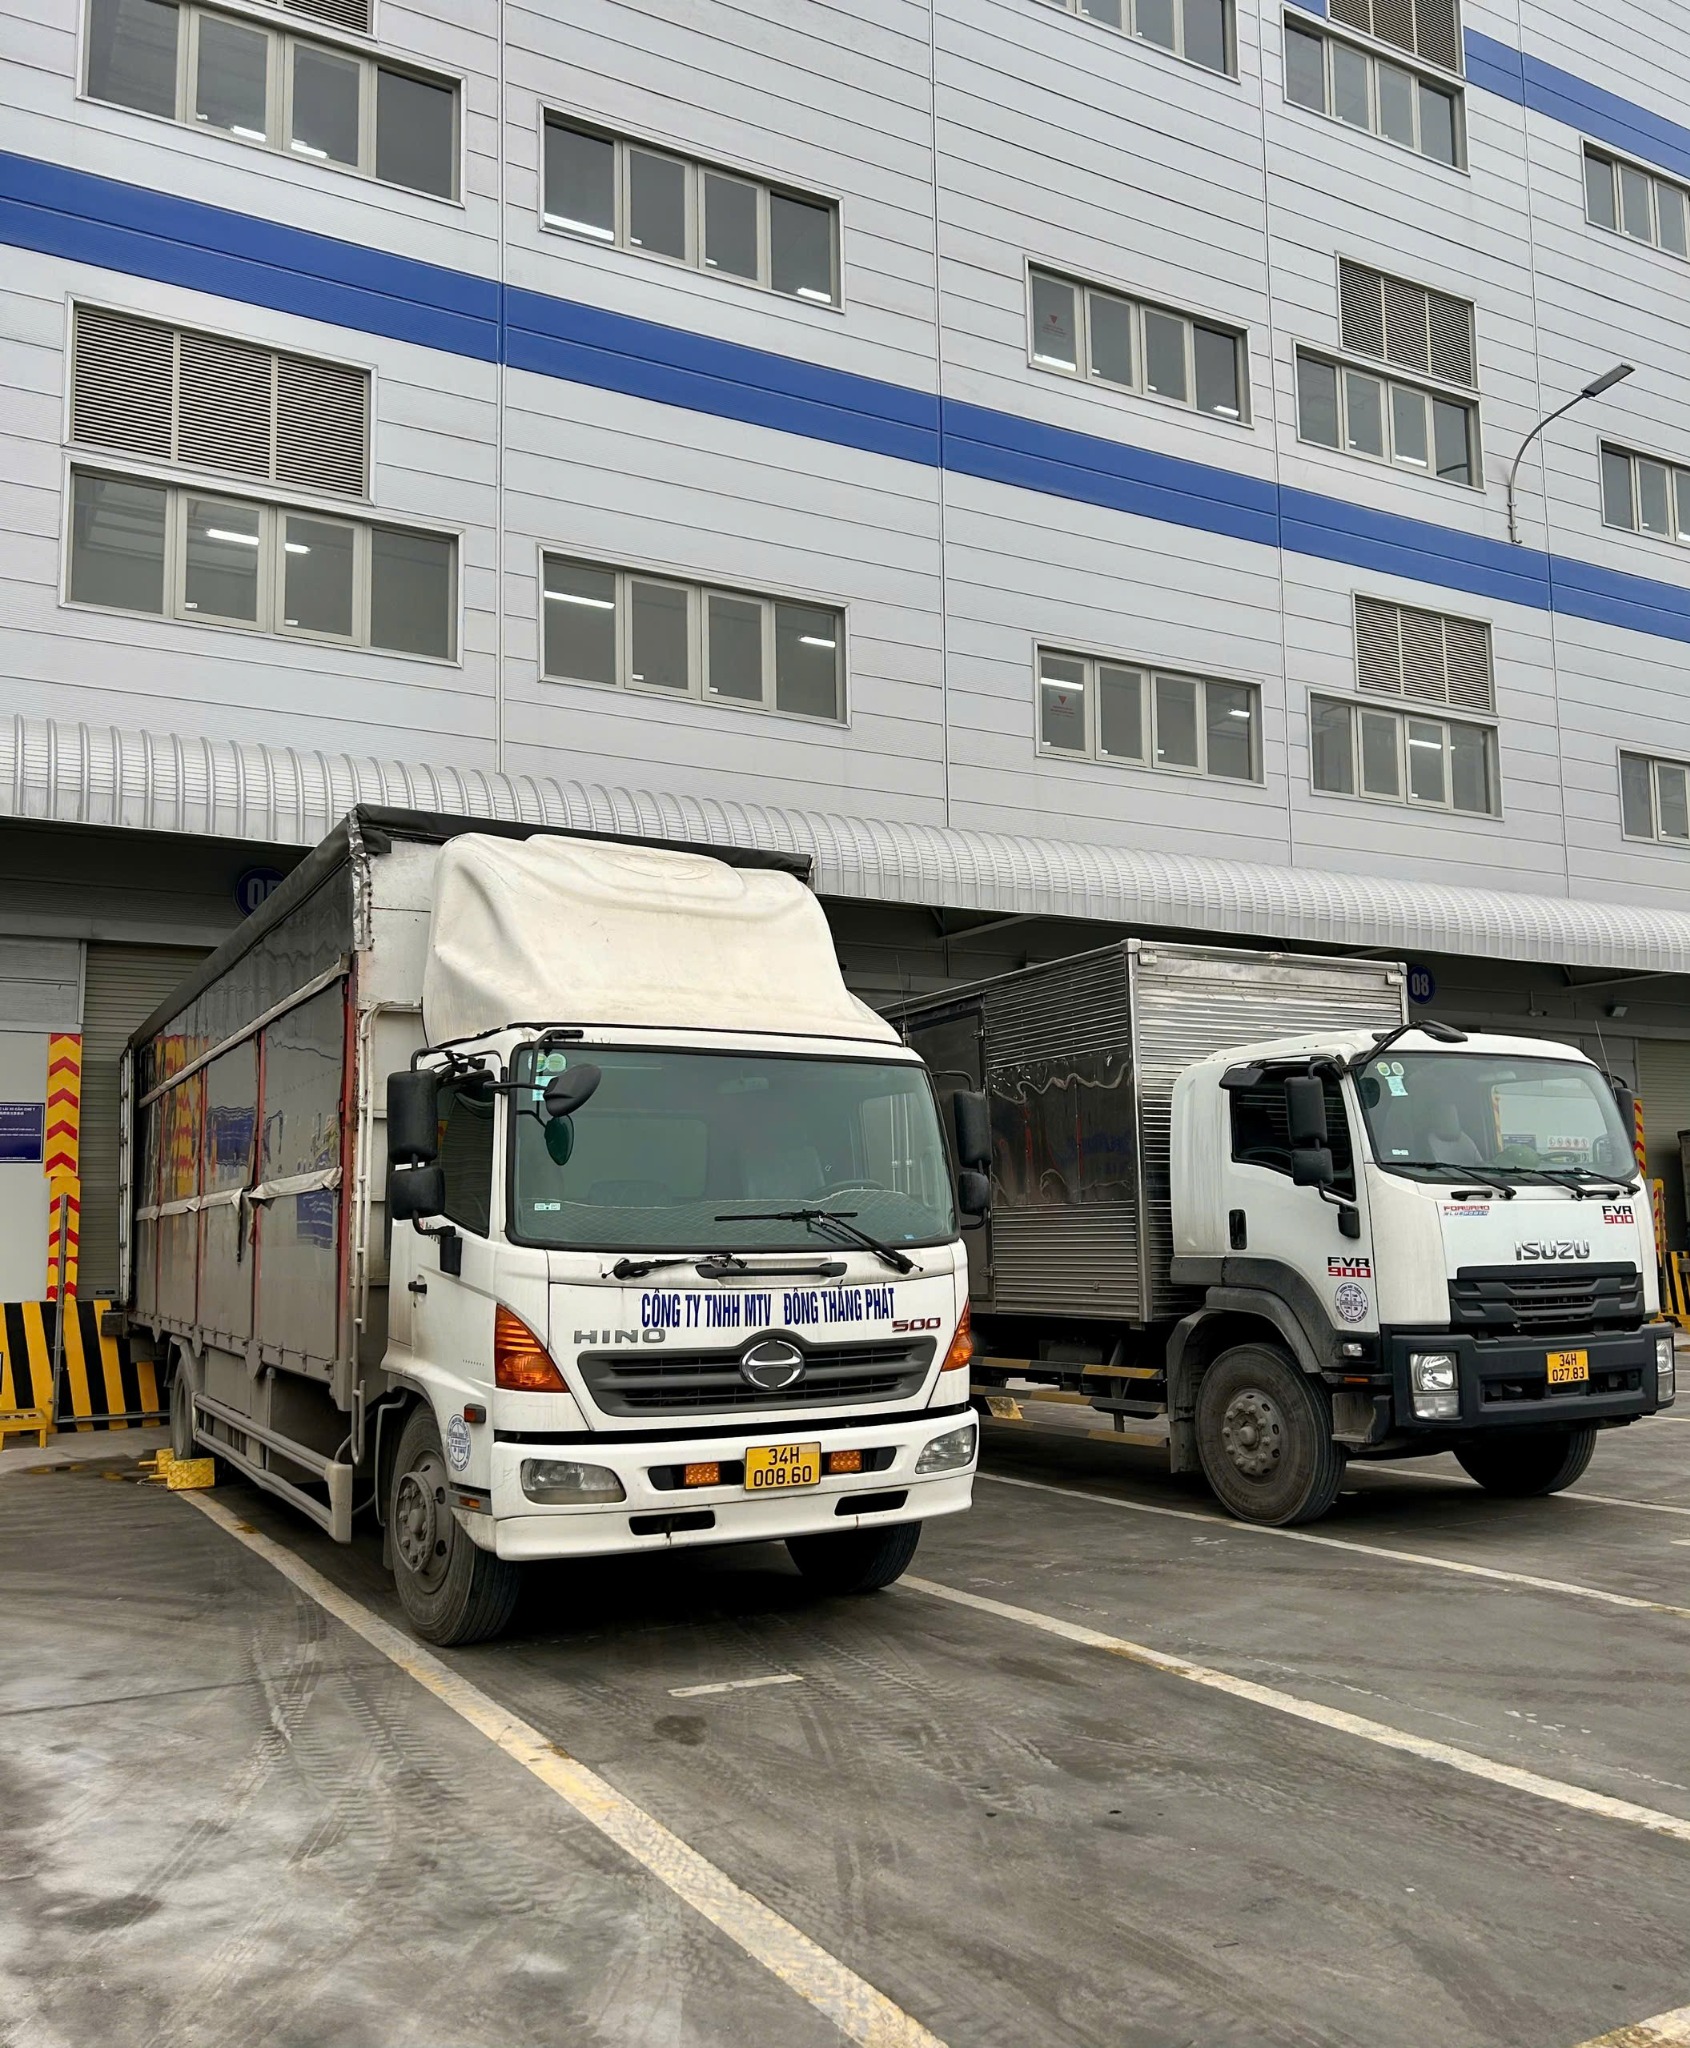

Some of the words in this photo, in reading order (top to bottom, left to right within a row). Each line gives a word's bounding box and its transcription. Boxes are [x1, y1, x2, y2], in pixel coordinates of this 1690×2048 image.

[1411, 973, 1430, 996] 08
[1602, 1205, 1633, 1215] FVR
[1604, 1215, 1635, 1224] 900
[1514, 1239, 1590, 1261] ISUZU
[1327, 1256, 1371, 1267] FVR
[1328, 1267, 1371, 1278] 900
[641, 1288, 680, 1328] CÔNG
[685, 1294, 701, 1328] TY
[705, 1294, 740, 1328] TNHH
[744, 1293, 771, 1327] MTV
[865, 1282, 895, 1321] PHÁT
[892, 1317, 941, 1333] 500
[574, 1328, 666, 1344] HINO
[1559, 1353, 1577, 1367] 34H
[1552, 1366, 1585, 1382] 027.83
[768, 1446, 800, 1466] 34H
[753, 1465, 812, 1488] 008.60
